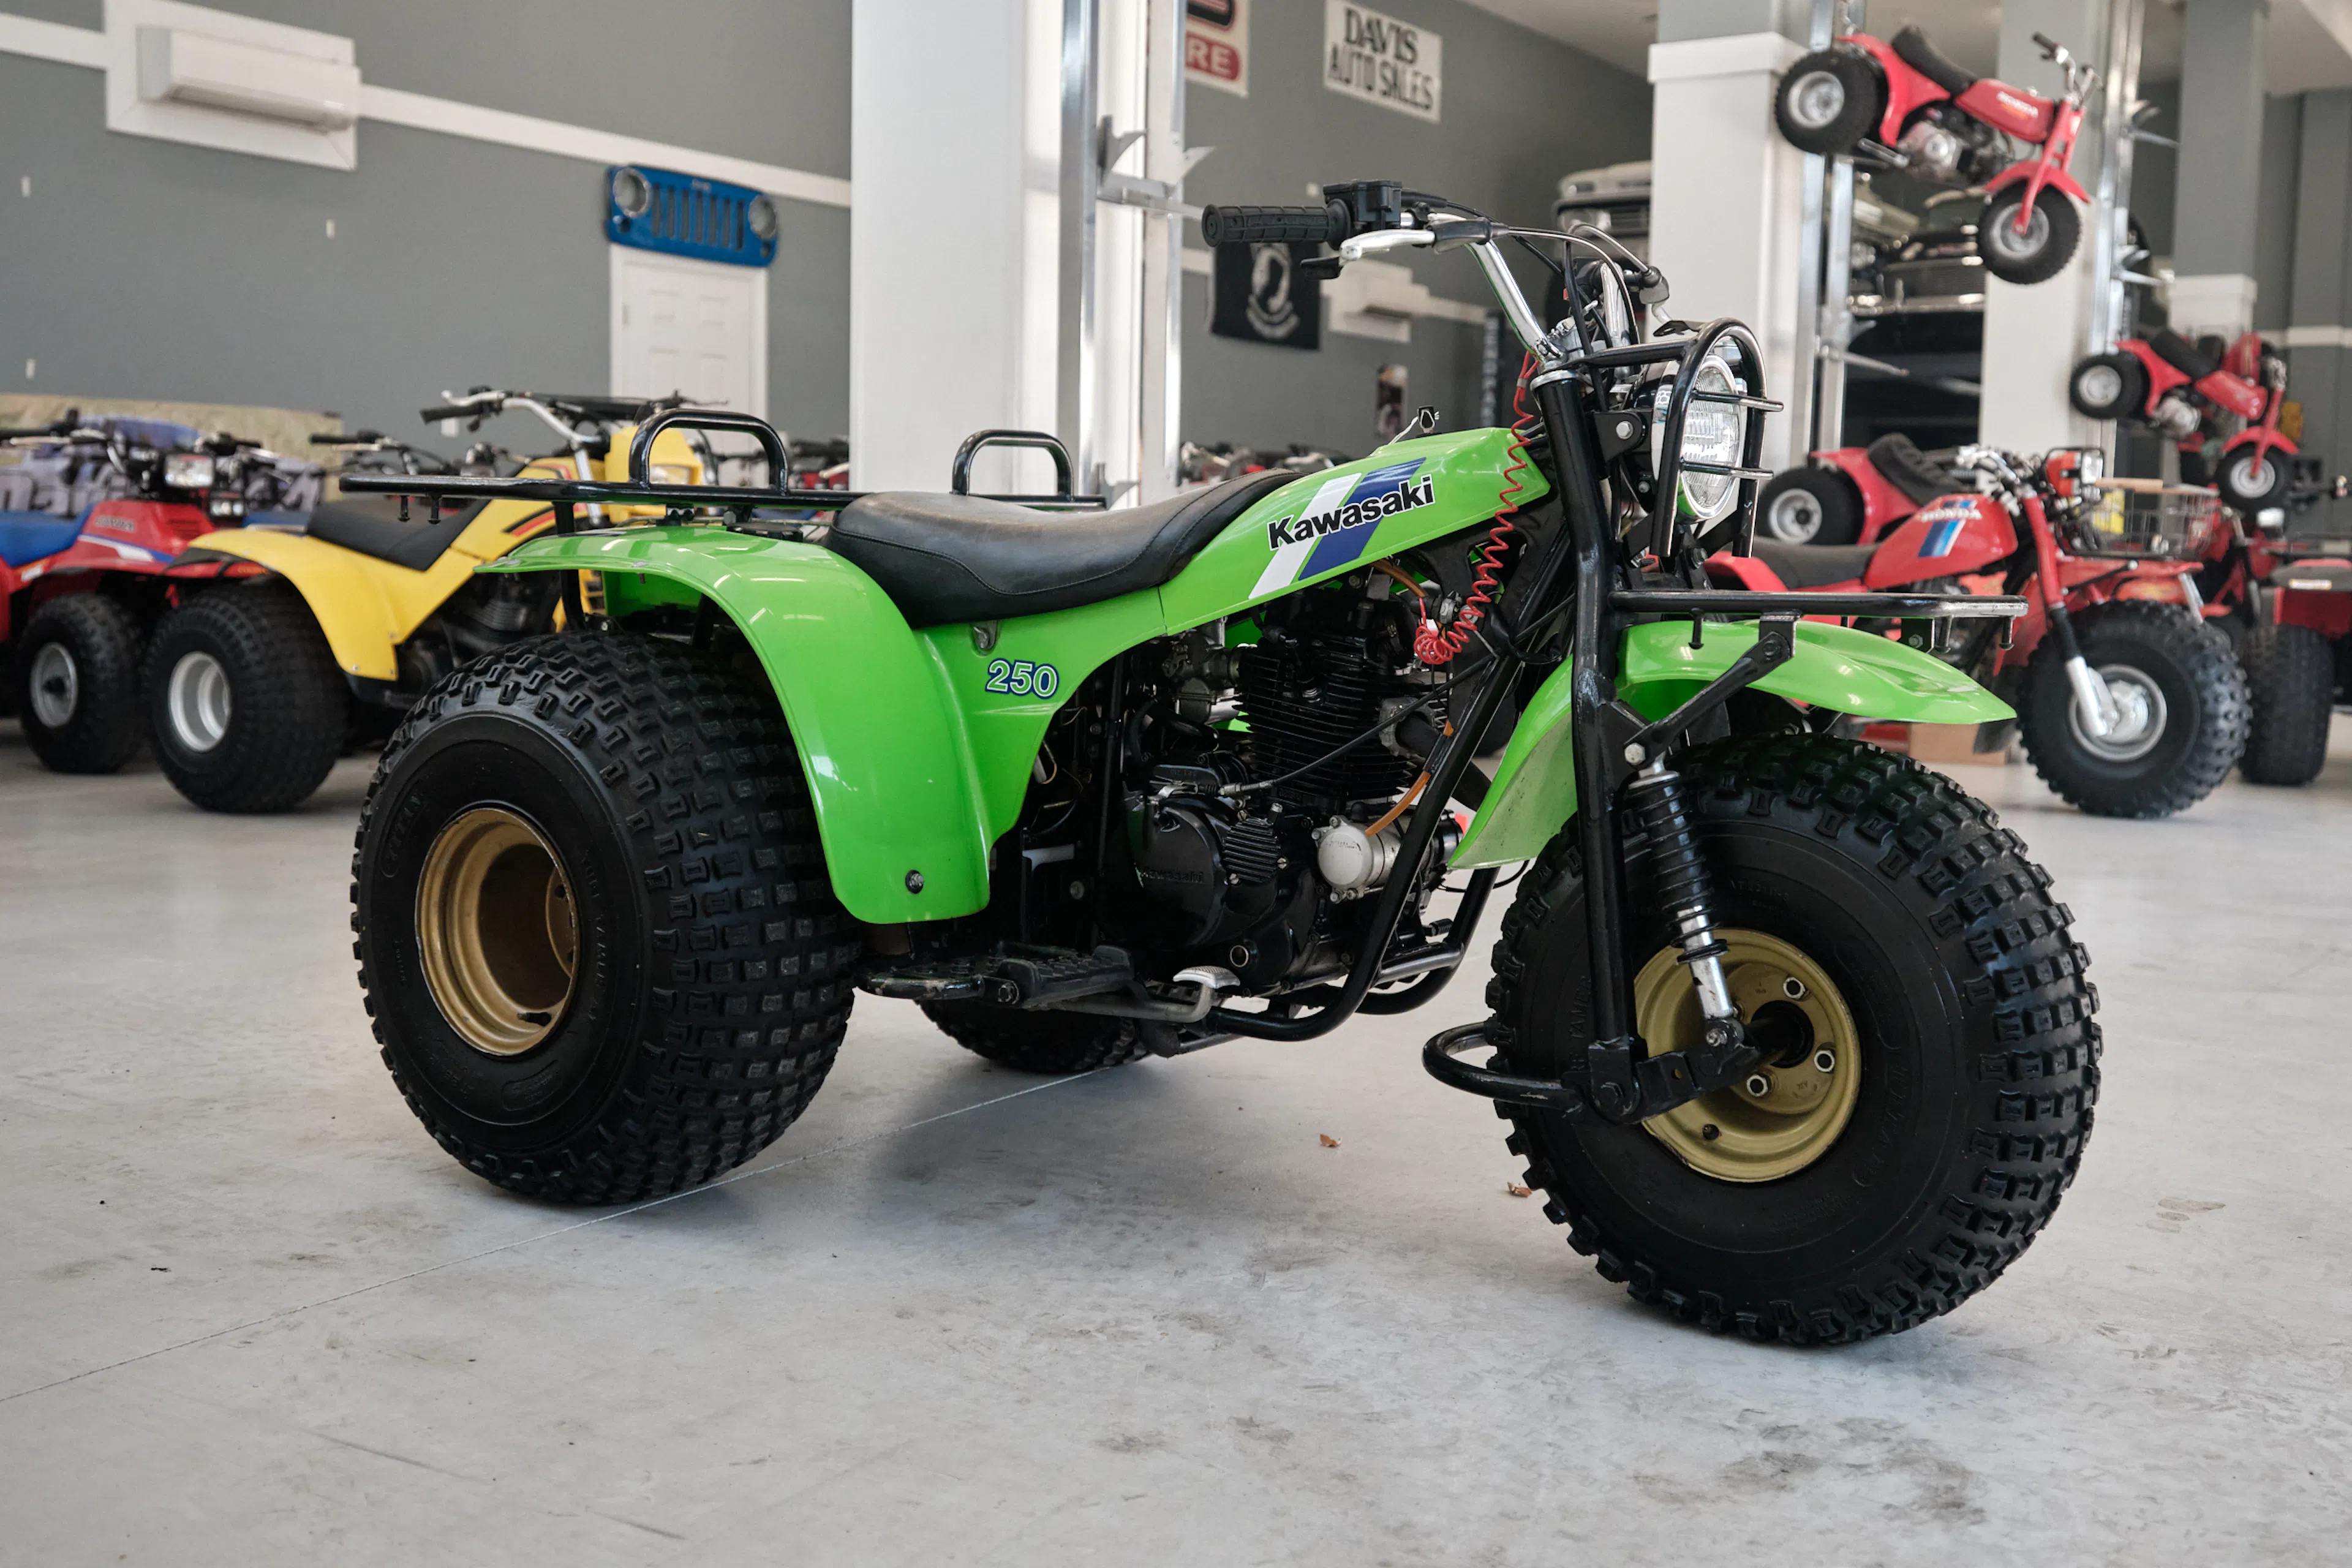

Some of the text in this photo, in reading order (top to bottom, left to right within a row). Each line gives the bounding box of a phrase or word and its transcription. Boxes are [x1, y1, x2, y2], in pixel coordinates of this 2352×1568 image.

[1344, 9, 1418, 65] DAVIS
[1327, 43, 1434, 111] AUTO SALES
[1267, 473, 1436, 551] Kawasaki
[1921, 508, 1983, 523] HONDA
[985, 657, 1060, 700] 250
